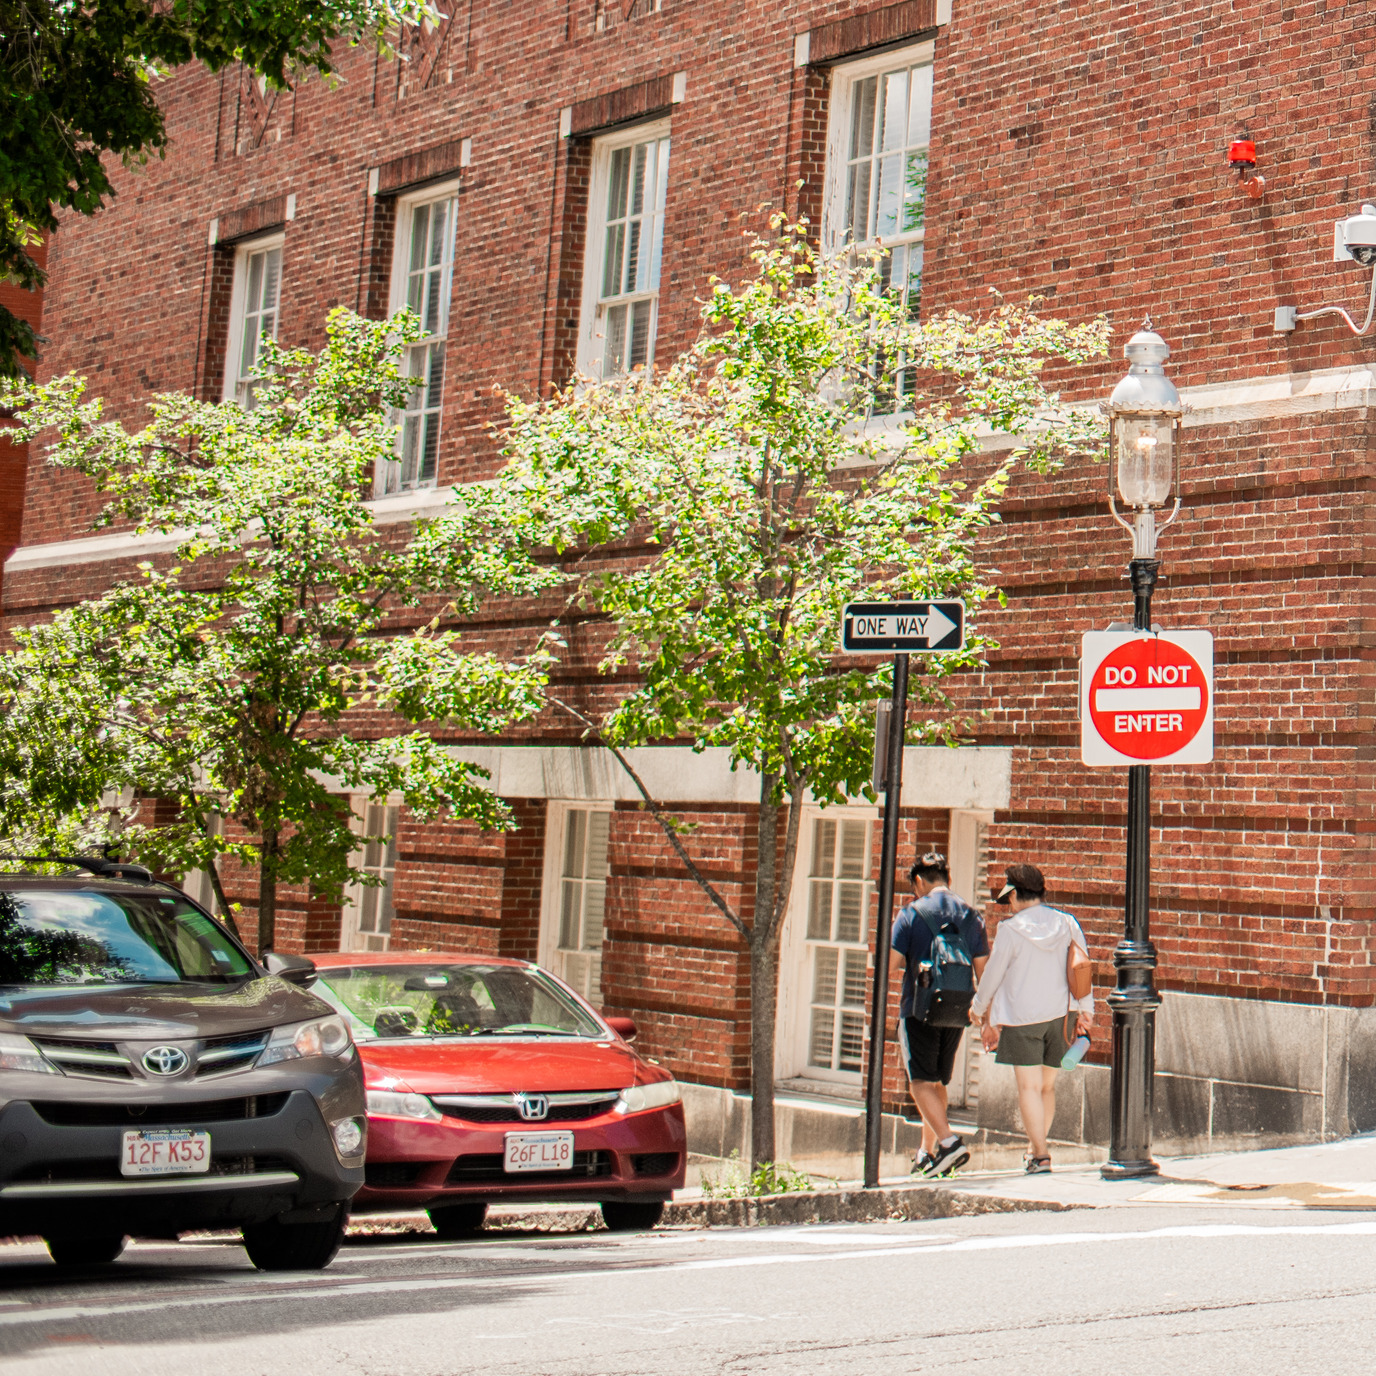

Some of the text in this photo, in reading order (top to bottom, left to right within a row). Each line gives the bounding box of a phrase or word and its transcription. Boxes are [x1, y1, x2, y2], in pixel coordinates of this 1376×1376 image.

[856, 617, 929, 636] ONE WAY
[1104, 665, 1193, 686] DO NOT
[1114, 713, 1184, 733] ENTER
[127, 1140, 205, 1165] 12F K53
[509, 1143, 569, 1163] 26F L18
